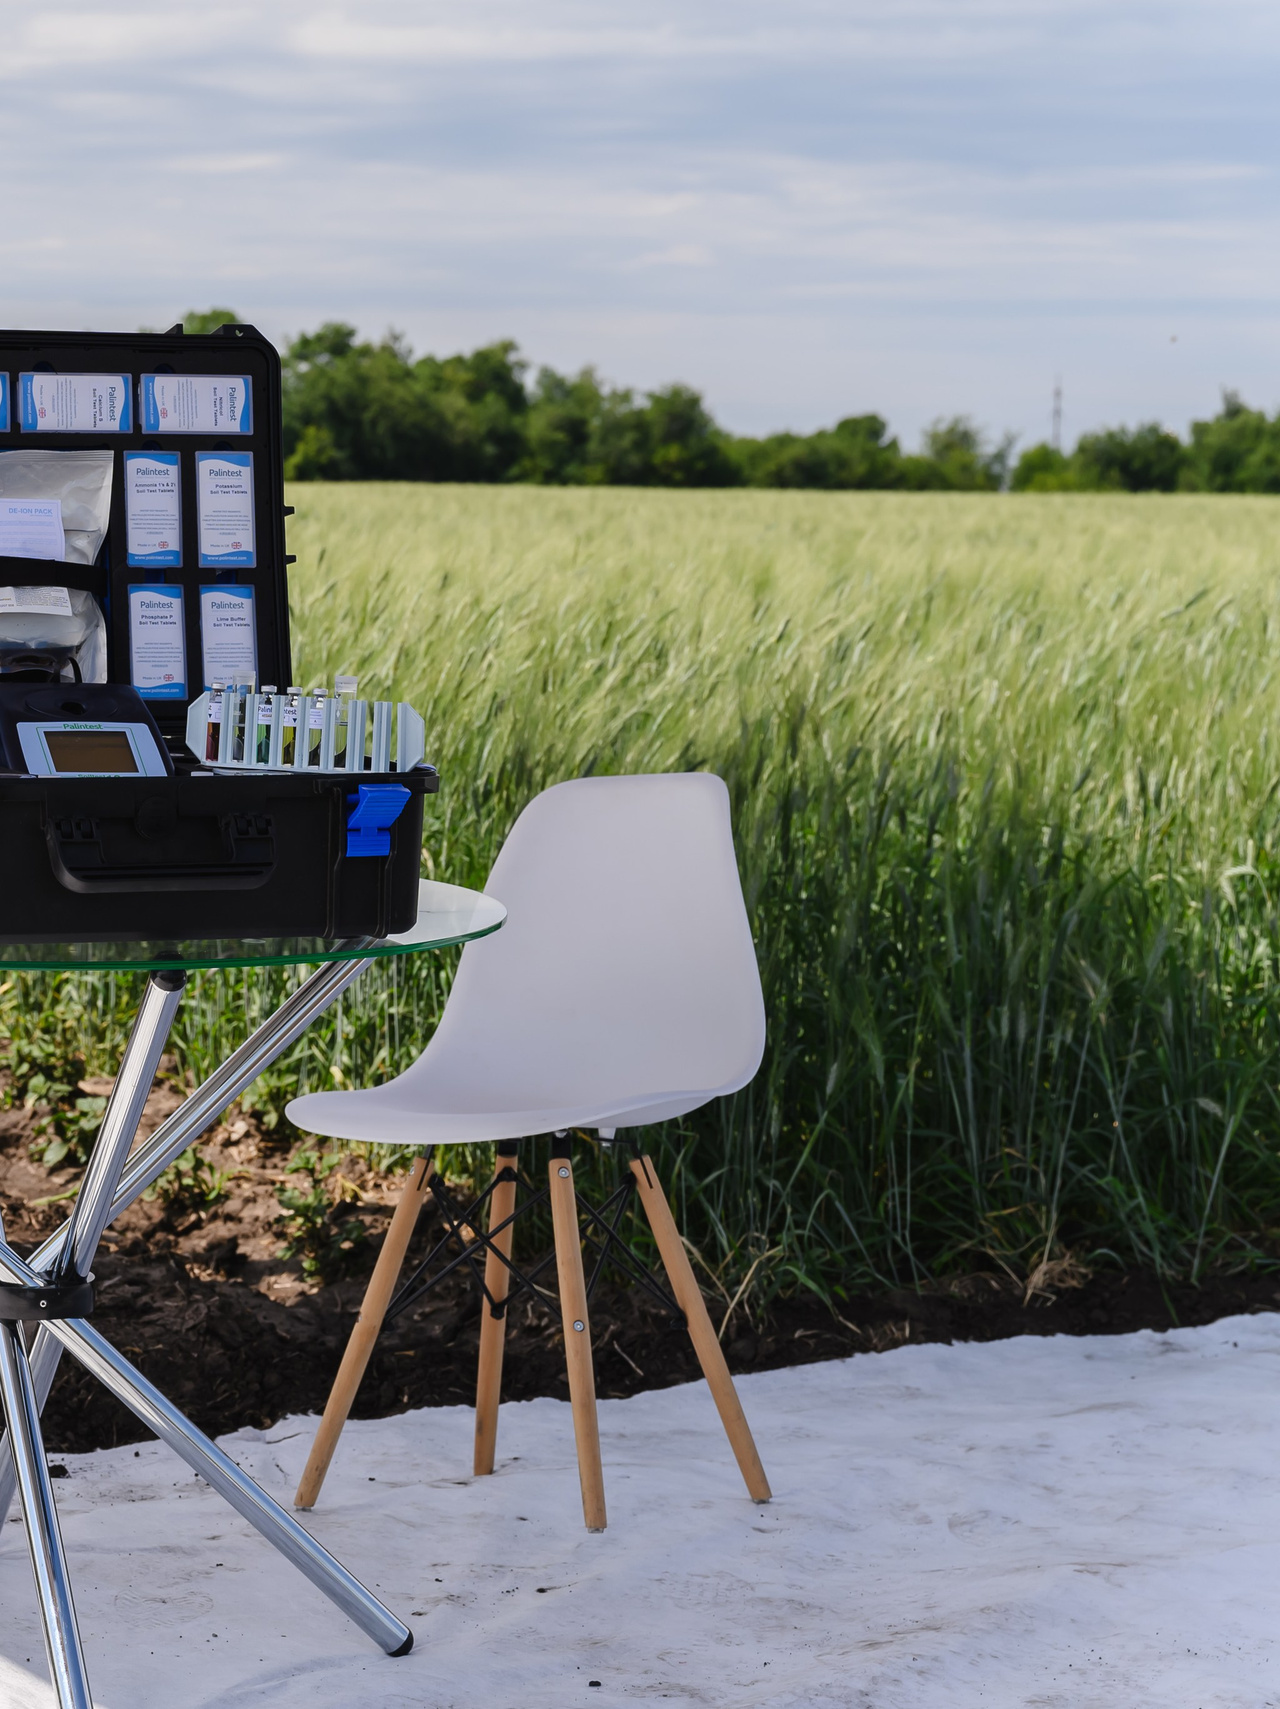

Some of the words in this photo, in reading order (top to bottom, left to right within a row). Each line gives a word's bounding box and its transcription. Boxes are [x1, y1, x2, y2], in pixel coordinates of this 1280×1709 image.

[108, 386, 116, 421] Palintest
[229, 387, 237, 422] Palintest
[136, 468, 170, 476] Palintest
[209, 469, 242, 477] Palintest
[140, 601, 173, 609] Palintest
[211, 601, 244, 609] Palintest
